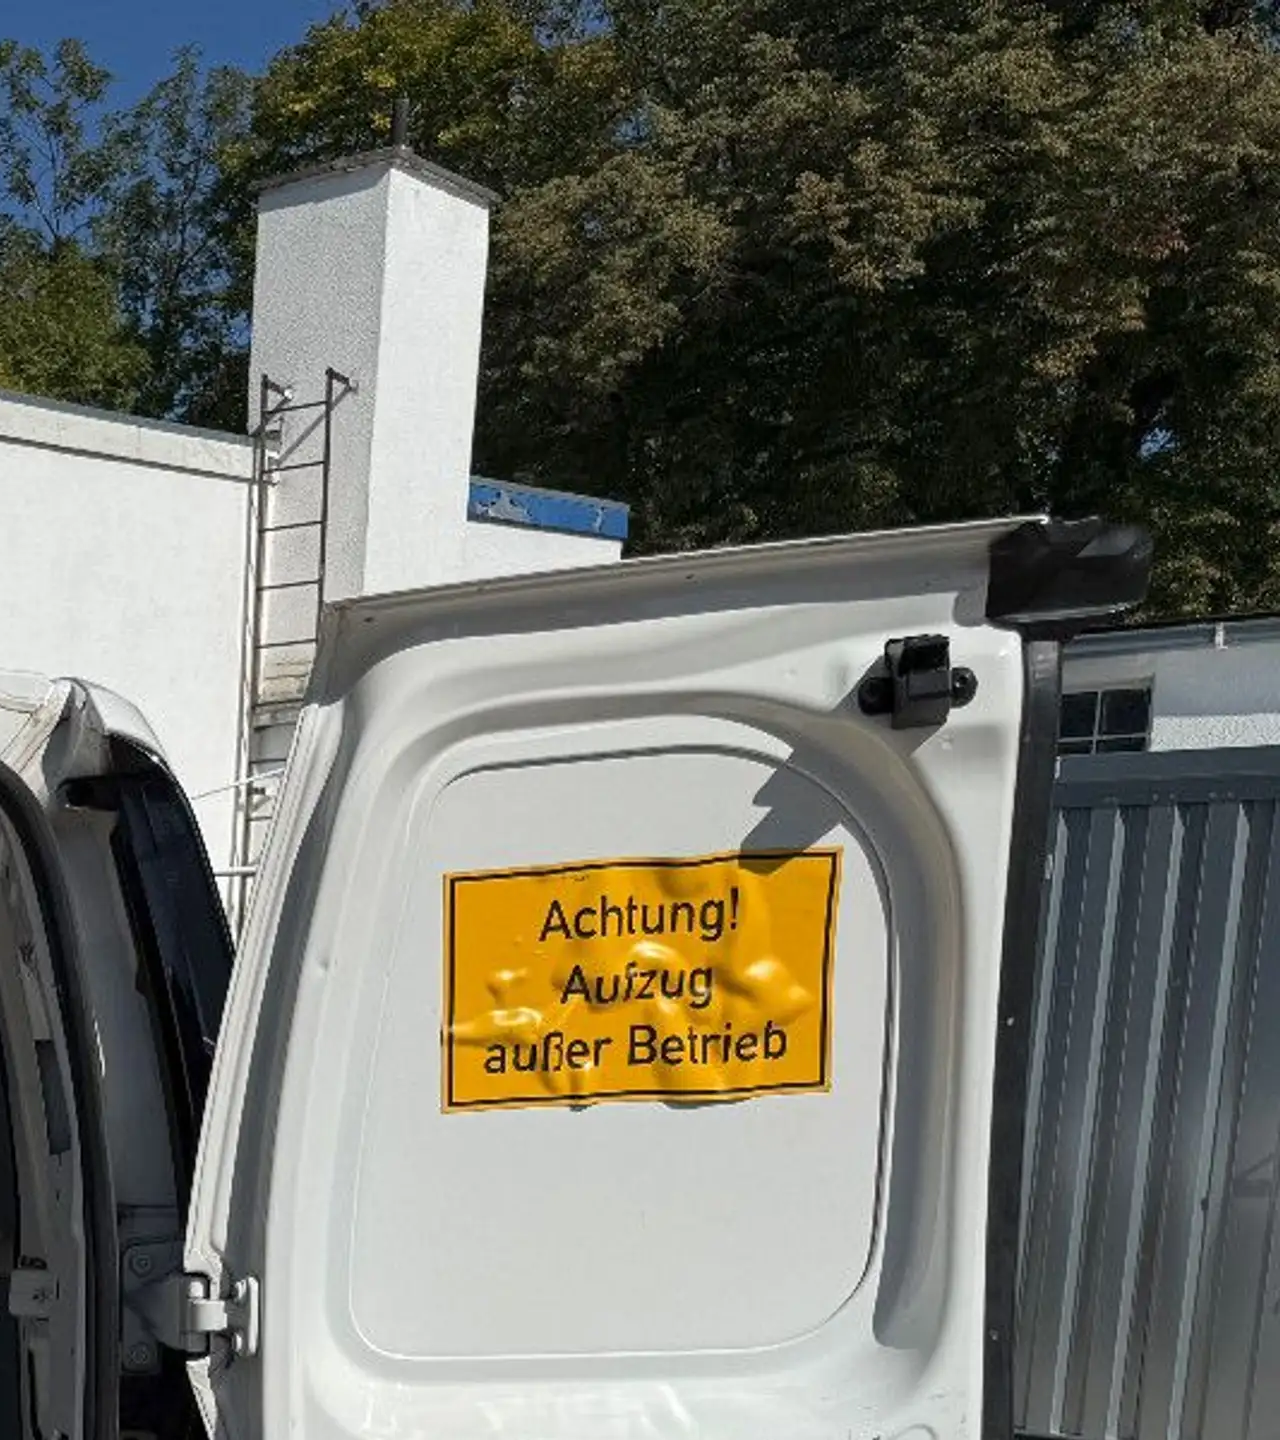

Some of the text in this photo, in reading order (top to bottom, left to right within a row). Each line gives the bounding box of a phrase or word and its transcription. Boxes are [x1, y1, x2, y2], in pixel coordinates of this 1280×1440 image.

[539, 886, 740, 942] Achtung!
[561, 961, 714, 1010] Aufzug
[483, 1020, 789, 1074] außer Betrieb
